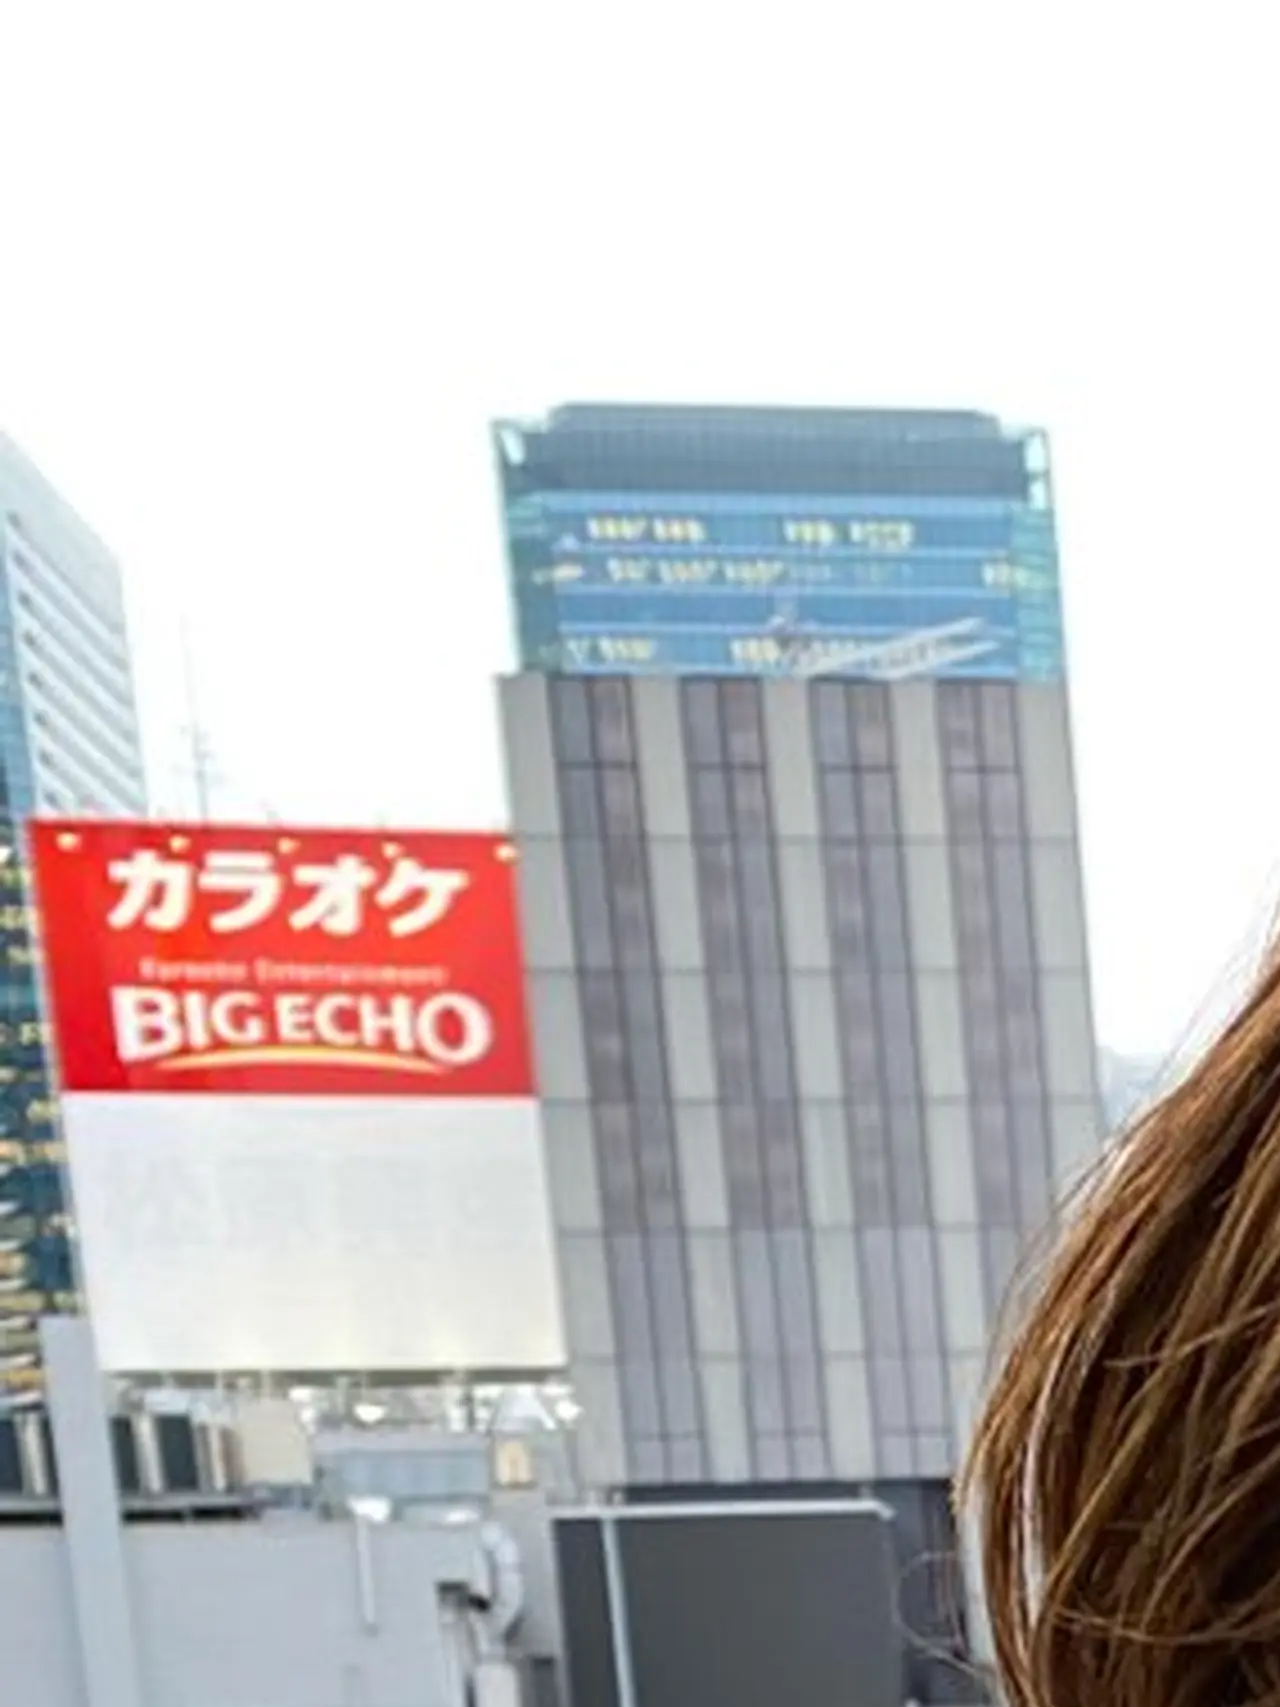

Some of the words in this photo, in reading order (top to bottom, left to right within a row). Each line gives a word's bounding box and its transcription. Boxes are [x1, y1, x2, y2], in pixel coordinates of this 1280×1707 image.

[106, 849, 470, 938] カラオケ
[109, 985, 264, 1065] BIG
[273, 991, 493, 1067] ECHO
